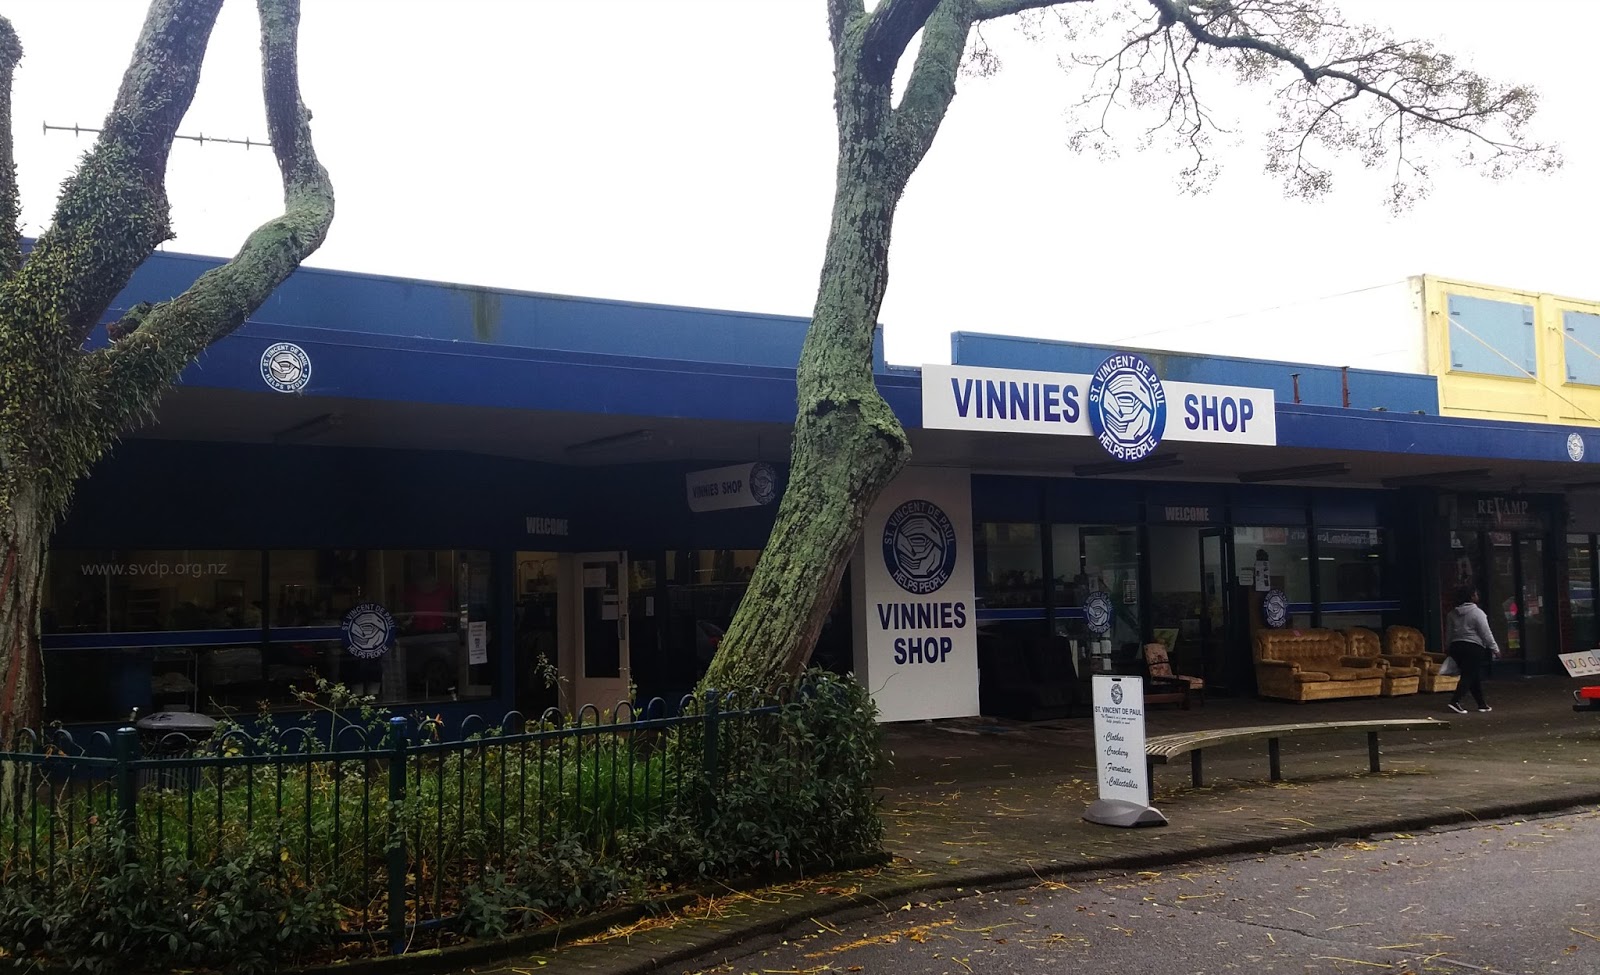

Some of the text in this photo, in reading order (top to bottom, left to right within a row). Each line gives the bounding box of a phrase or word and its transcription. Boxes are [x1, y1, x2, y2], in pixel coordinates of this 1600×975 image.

[266, 345, 288, 358] VINCENT
[290, 346, 298, 354] DE
[298, 353, 308, 367] PAUL
[265, 373, 308, 390] HELPS PEOPLE
[1095, 355, 1135, 382] VINCENT
[1136, 359, 1150, 377] DE
[1148, 374, 1164, 408] PAUL
[951, 377, 1254, 433] VINNIES SHOP
[1098, 431, 1158, 460] HELPS PEOPLE
[692, 480, 742, 498] VINNIES SHOP
[891, 502, 926, 528] VINCENT
[928, 504, 940, 520] DE
[939, 517, 954, 545] PAUL
[1164, 506, 1210, 521] WELCOME
[525, 516, 569, 536] WELCOME
[81, 560, 228, 578] www.svdp.org.nz
[893, 569, 948, 592] HELPS PEOPLE
[345, 603, 375, 619] VINCENT
[375, 604, 385, 614] DE
[383, 611, 396, 630] PAUL
[877, 602, 966, 630] VINNIES
[347, 644, 389, 659] HELPS PEOPLE
[894, 637, 952, 665] SHOP
[1102, 706, 1121, 715] VINCENT
[1130, 708, 1142, 716] PAUL
